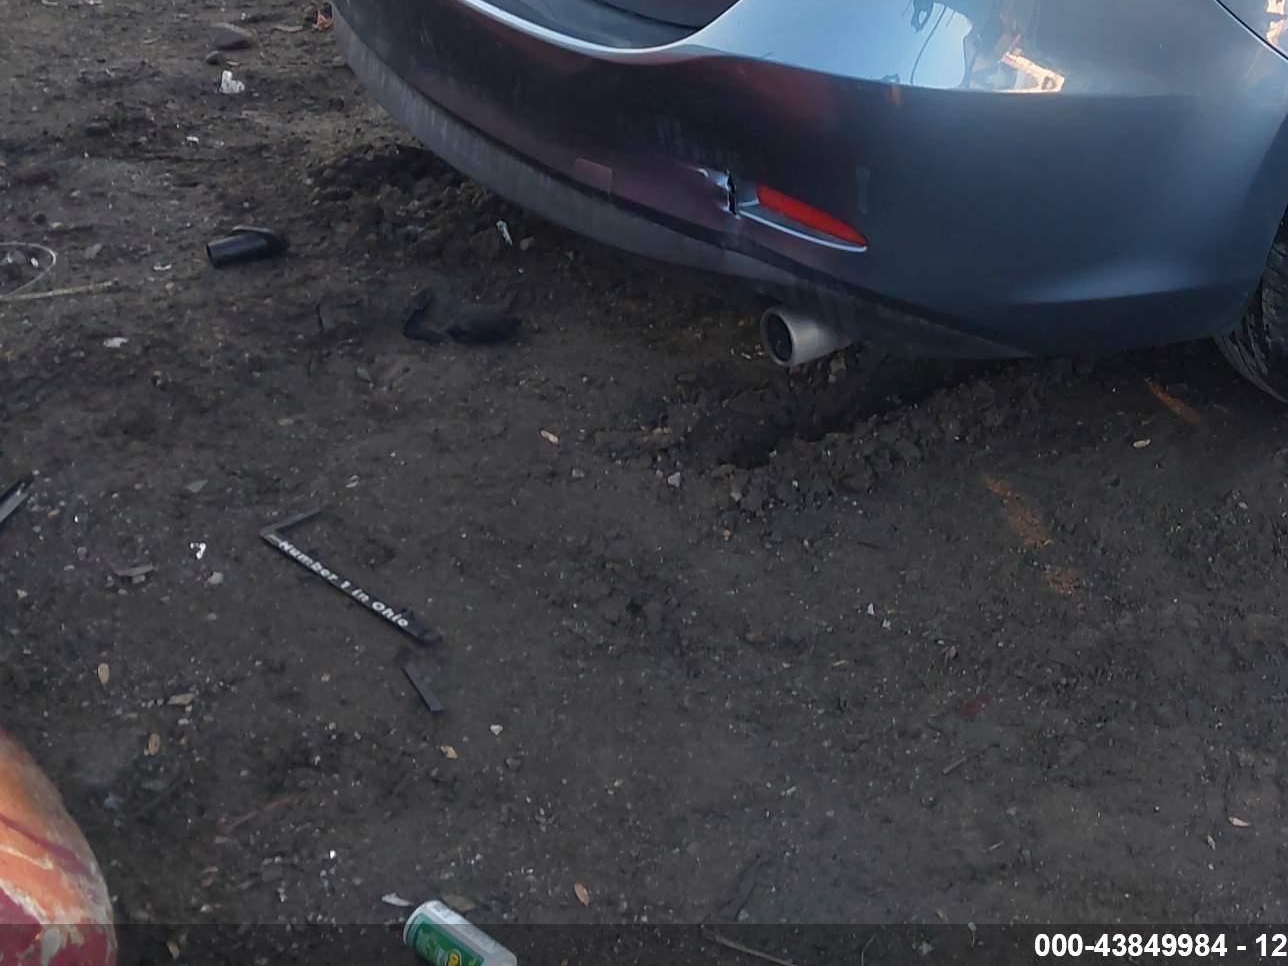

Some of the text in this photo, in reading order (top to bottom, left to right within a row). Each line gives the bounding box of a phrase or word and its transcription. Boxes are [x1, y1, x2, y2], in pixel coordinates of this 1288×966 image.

[279, 540, 339, 583] Number
[351, 588, 370, 603] in
[372, 601, 409, 627] Ohio
